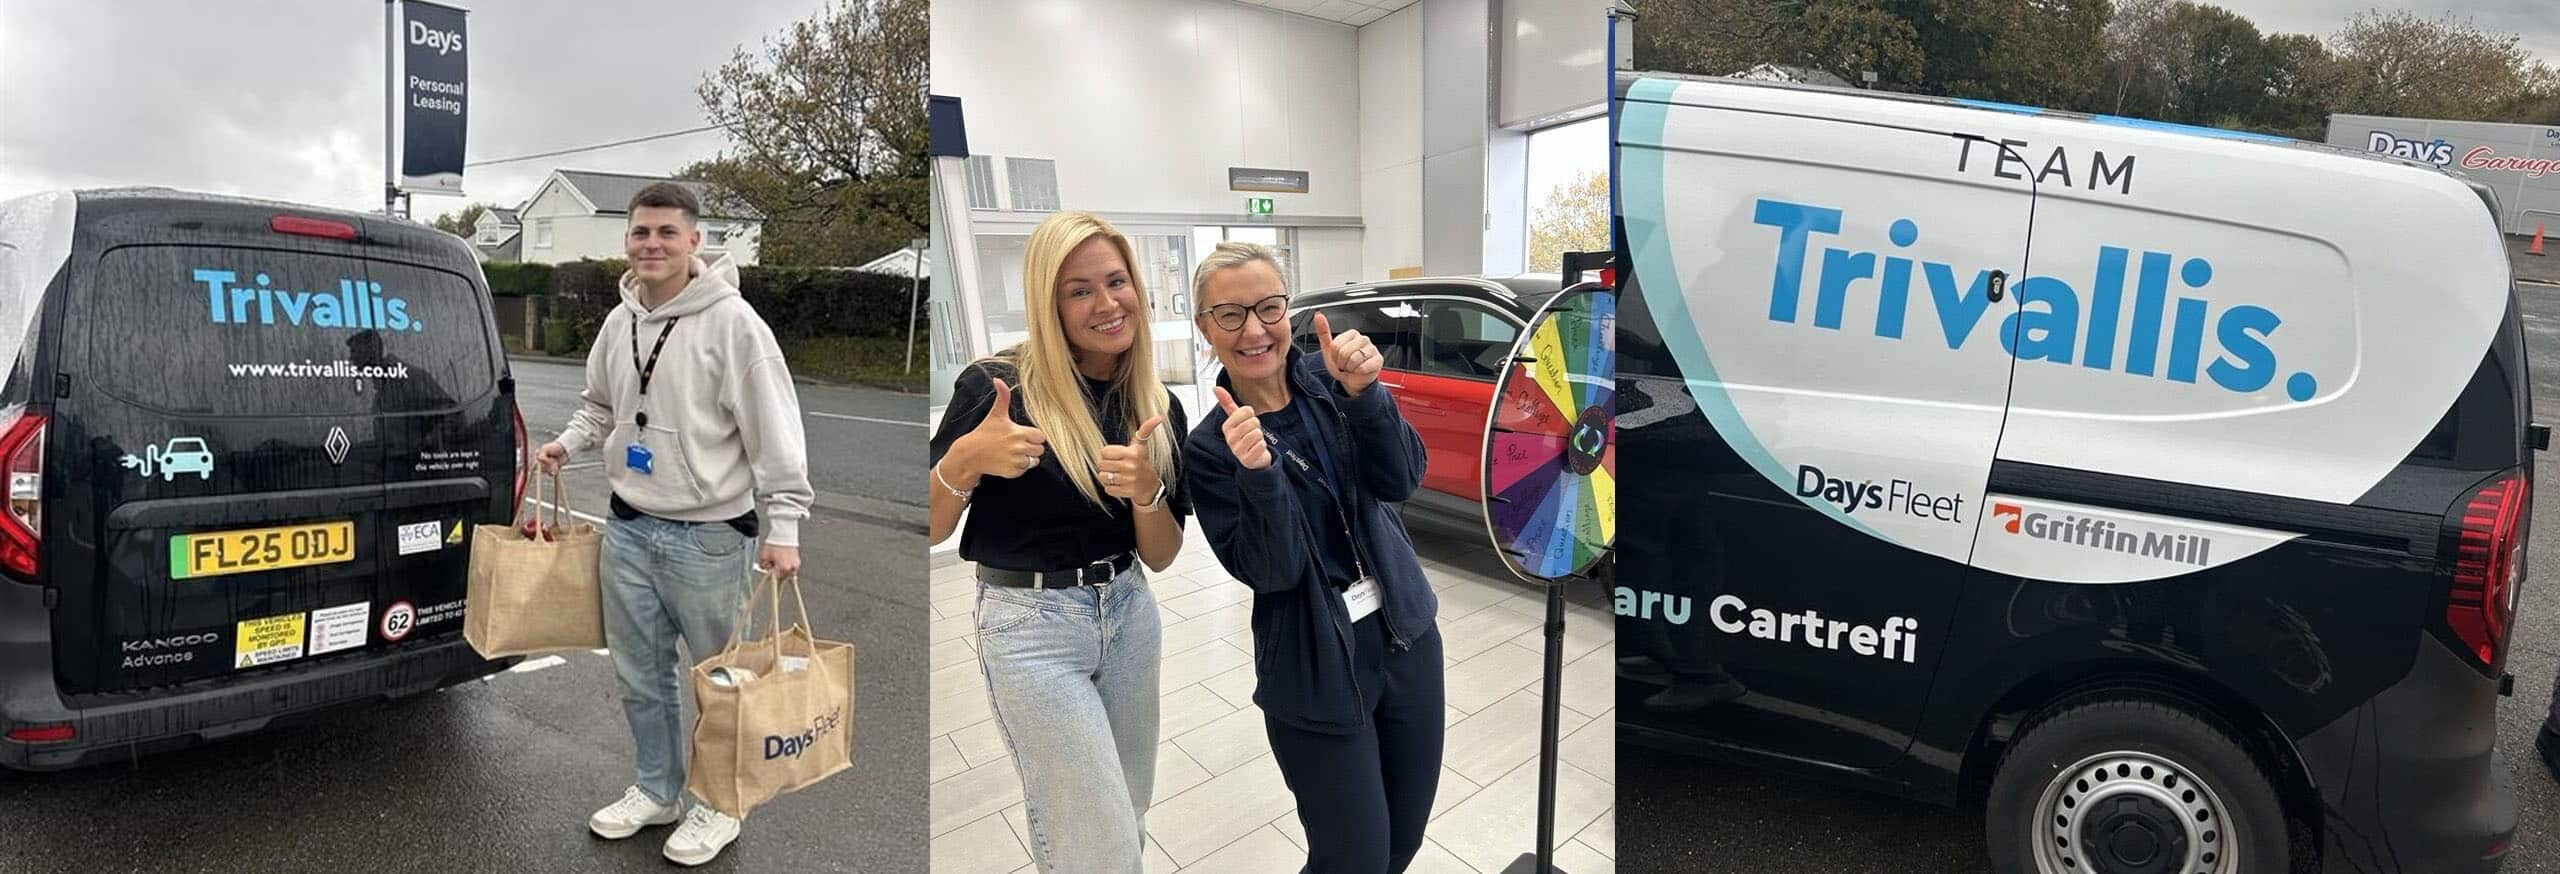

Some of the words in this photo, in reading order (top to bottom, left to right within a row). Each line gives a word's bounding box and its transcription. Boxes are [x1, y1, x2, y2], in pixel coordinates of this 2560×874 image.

[409, 20, 463, 56] Day's
[410, 75, 464, 96] Personal
[413, 94, 461, 115] Leasing
[1952, 132, 2136, 195] TEAM
[193, 268, 423, 332] Trivallis.
[1753, 198, 2317, 402] Trivallis.
[228, 359, 409, 379] www.trivallis.co.uk
[1796, 464, 1883, 513] Day's
[1888, 479, 1964, 524] Fleet
[414, 523, 440, 539] ECA
[194, 532, 282, 571] FL25
[291, 527, 349, 560] ODJ
[254, 624, 282, 634] SPEED
[388, 613, 409, 631] 62
[1615, 585, 1692, 625] aru
[1709, 594, 1919, 663] Cartrefi
[122, 632, 219, 651] KANGOO
[248, 630, 297, 642] MONITORED
[269, 639, 286, 648] GPS
[121, 651, 194, 669] Advance
